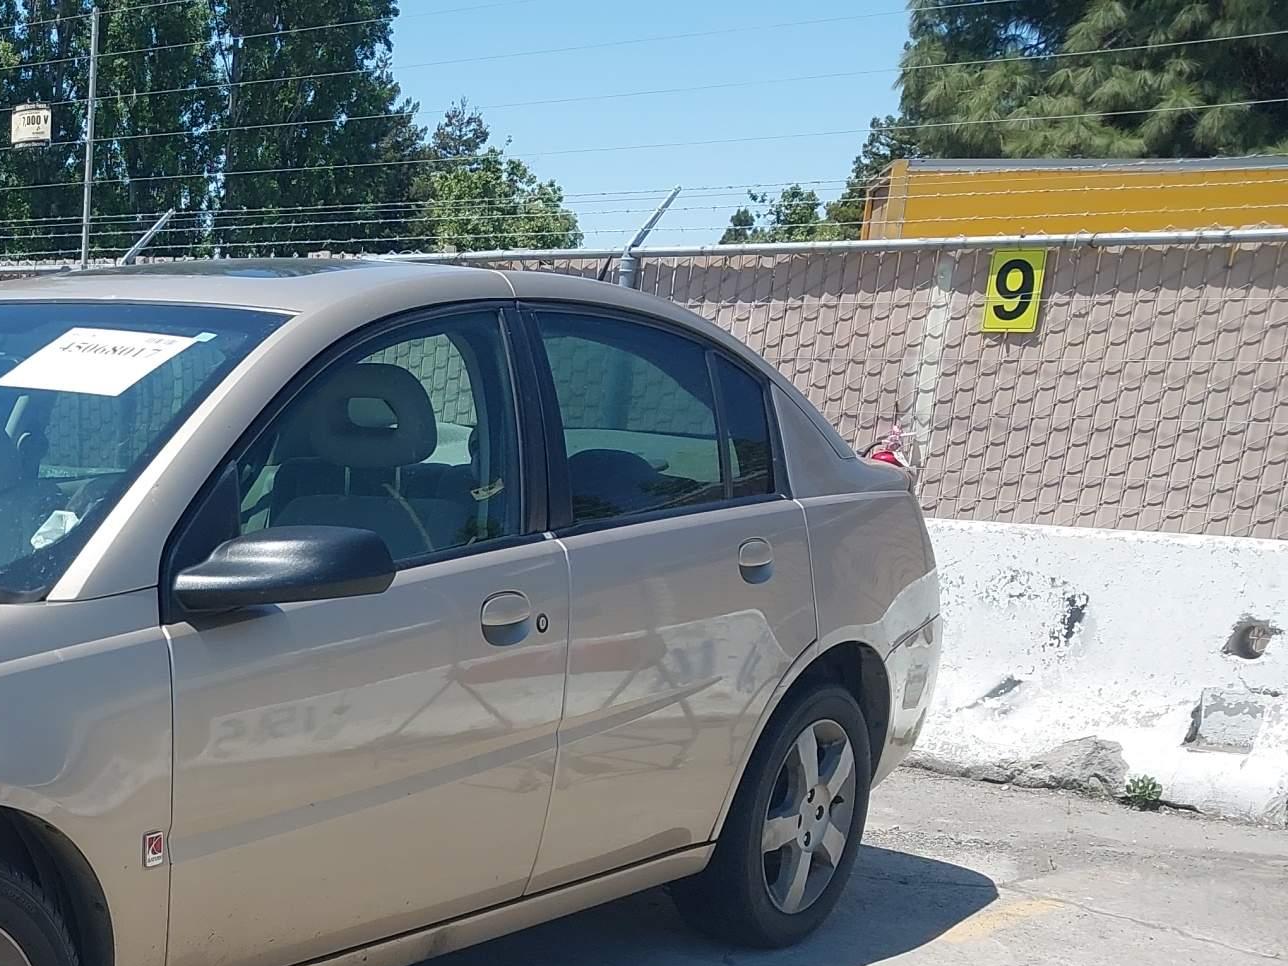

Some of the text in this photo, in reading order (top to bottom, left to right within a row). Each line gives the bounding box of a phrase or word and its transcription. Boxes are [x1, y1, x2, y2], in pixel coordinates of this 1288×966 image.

[22, 114, 49, 127] 7,000 V
[993, 259, 1034, 320] 9
[61, 341, 163, 358] 45068017
